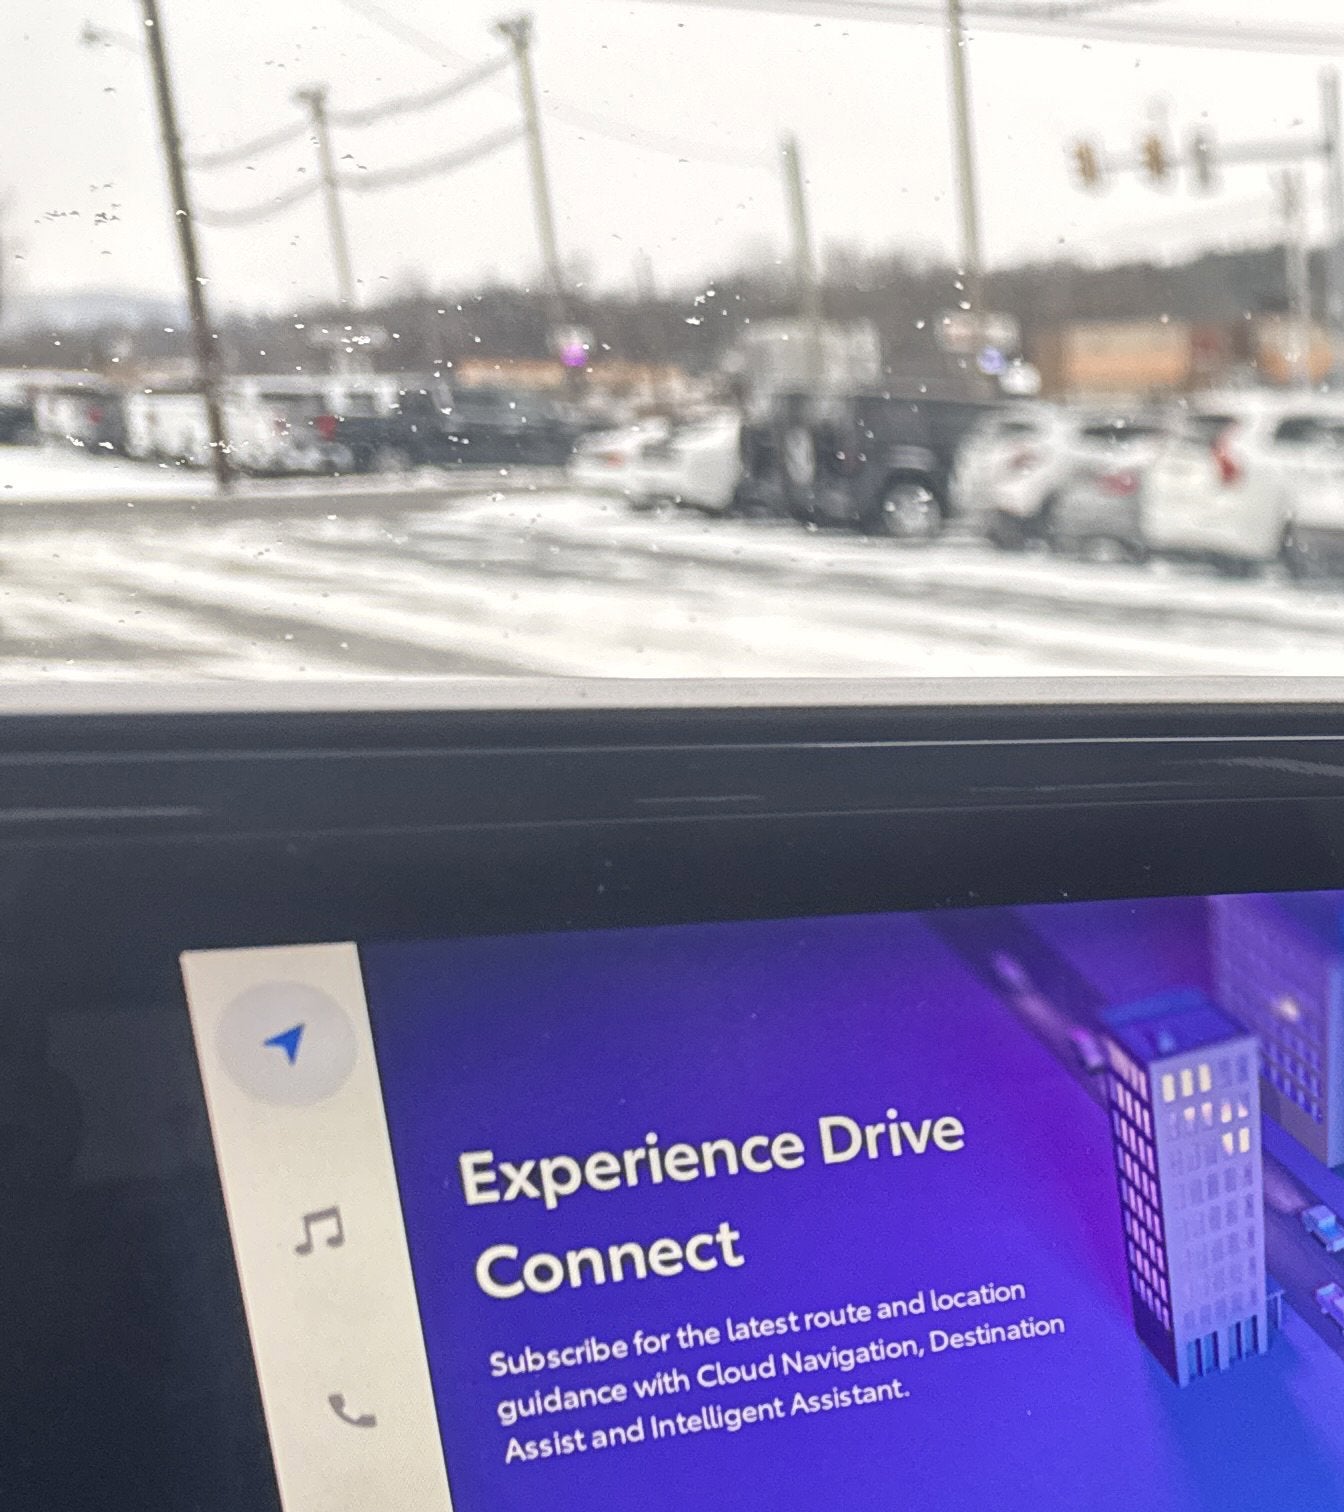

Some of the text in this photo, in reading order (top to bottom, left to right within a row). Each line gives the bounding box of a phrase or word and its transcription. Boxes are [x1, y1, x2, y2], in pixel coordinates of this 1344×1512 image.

[458, 1107, 966, 1209] Experience Drive
[473, 1220, 746, 1299] Connect
[489, 1281, 1027, 1377] Subscribe for the latest route and location
[496, 1316, 1066, 1427] guidance with Cloud Navigation, Destination
[504, 1378, 911, 1465] Assist and Intelligent Assistant.
